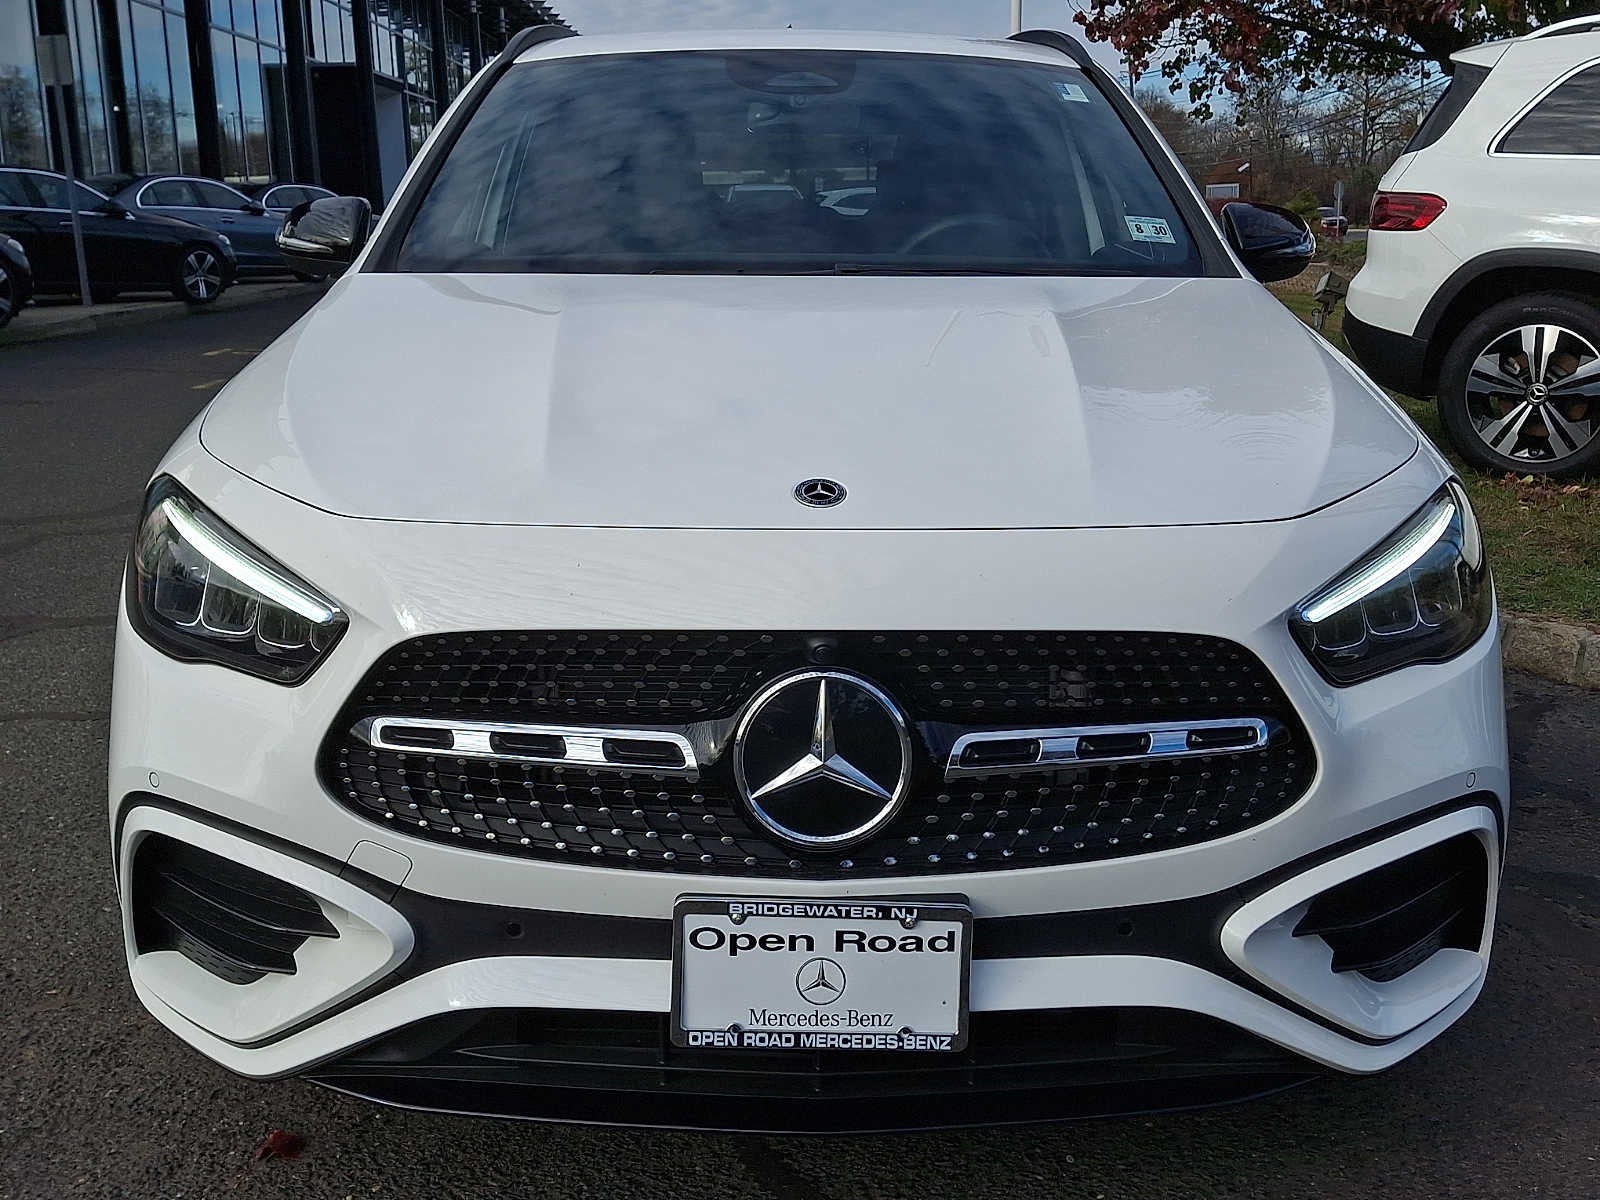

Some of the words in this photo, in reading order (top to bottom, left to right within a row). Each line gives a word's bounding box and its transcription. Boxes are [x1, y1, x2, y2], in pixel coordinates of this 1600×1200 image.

[1134, 223, 1145, 234] 8
[1151, 225, 1168, 236] 30
[729, 903, 883, 919] BRIDGEWATER,
[890, 907, 918, 919] NJ
[688, 926, 815, 956] Open
[834, 930, 956, 953] Road
[749, 1008, 894, 1027] Mercedes-Benz
[688, 1031, 738, 1047] OPEN
[743, 1032, 795, 1047] ROAD
